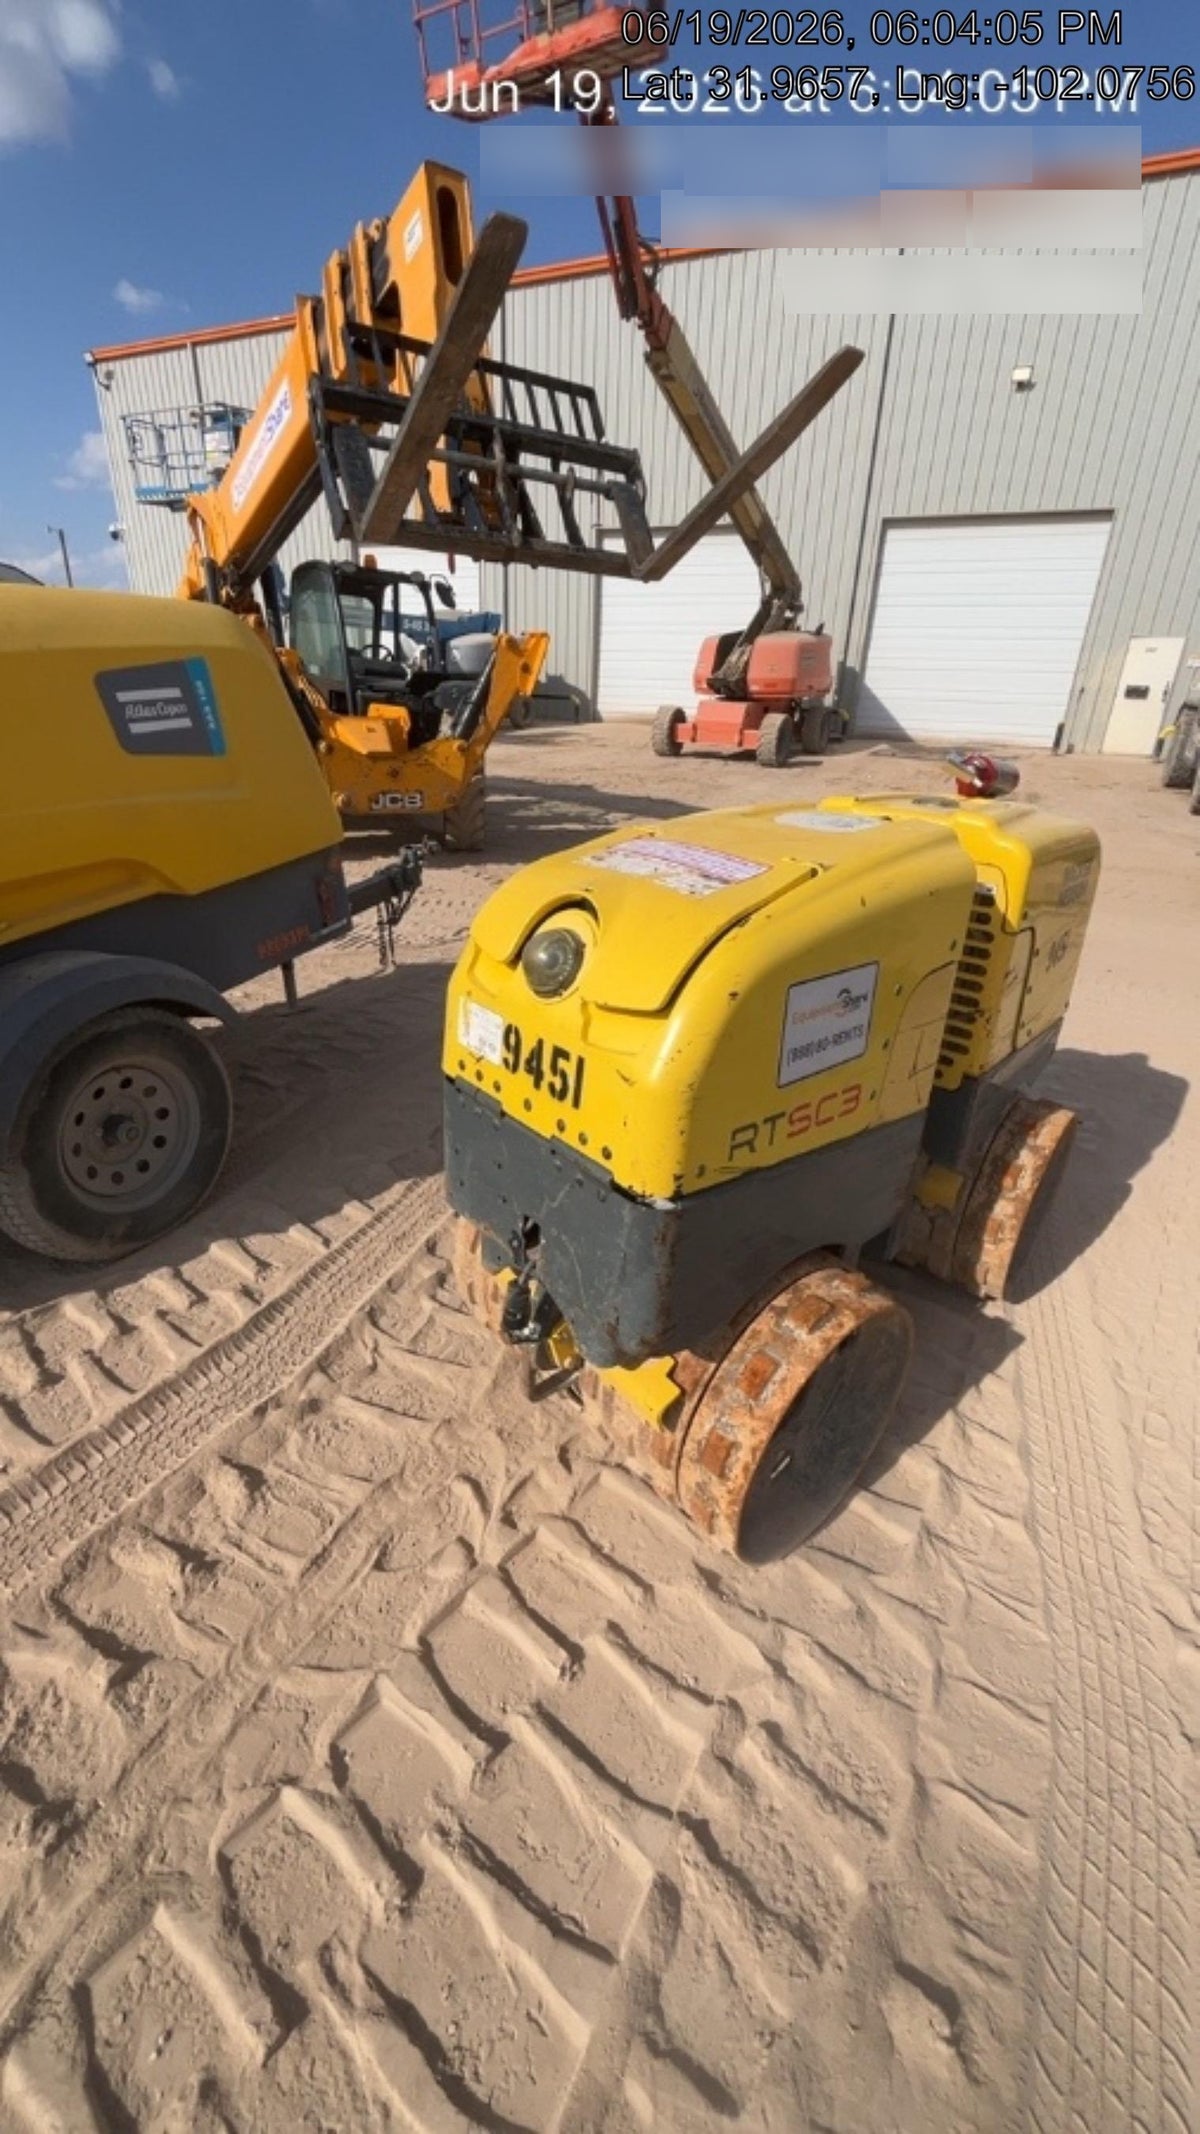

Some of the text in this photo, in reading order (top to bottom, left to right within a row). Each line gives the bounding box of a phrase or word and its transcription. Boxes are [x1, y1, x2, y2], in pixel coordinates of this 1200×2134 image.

[371, 793, 421, 810] JCB
[502, 1023, 586, 1111] 9451
[727, 1083, 862, 1162] RTSC3
